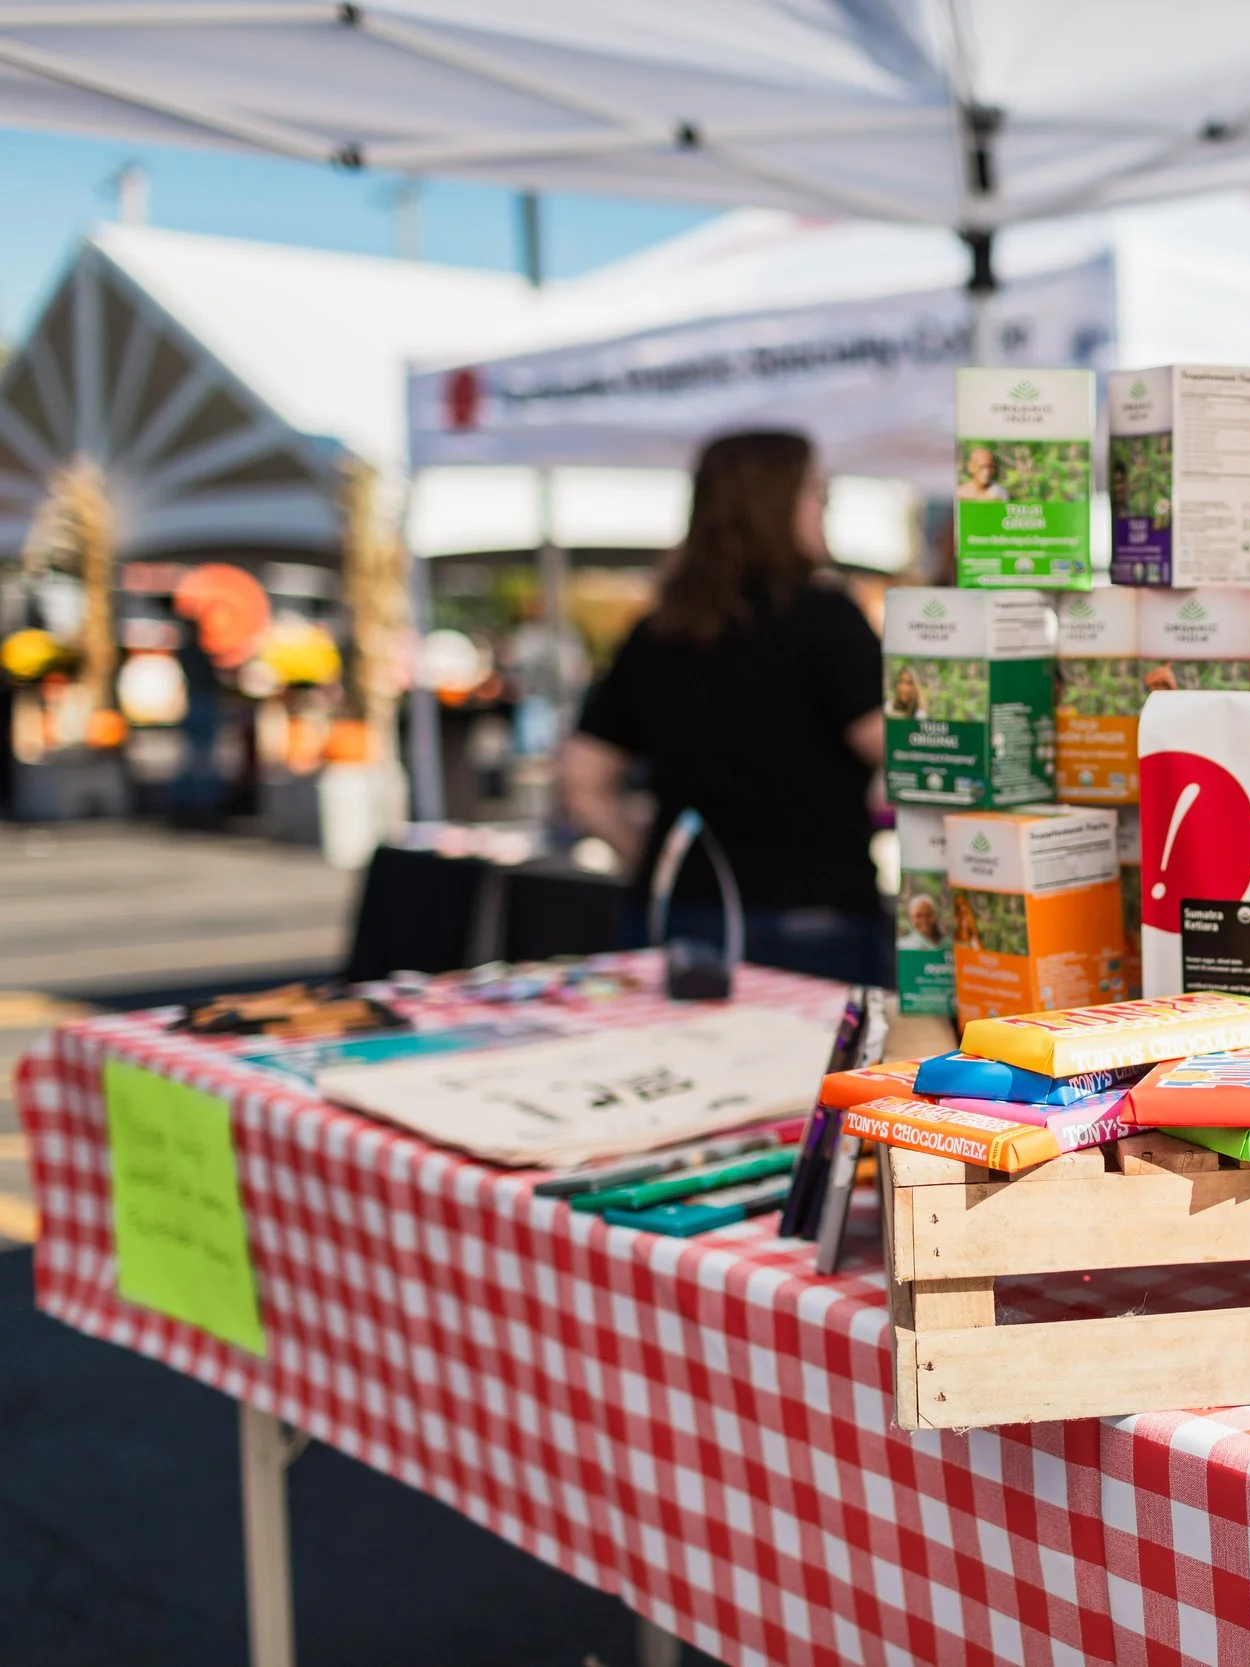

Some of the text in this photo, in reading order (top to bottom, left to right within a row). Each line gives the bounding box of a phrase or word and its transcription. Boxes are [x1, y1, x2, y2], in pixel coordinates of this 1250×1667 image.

[1184, 907, 1224, 922] Sumatra
[1069, 1039, 1145, 1074] TONY'S
[1068, 1068, 1114, 1097] TONY'S
[848, 1112, 890, 1139] TONY'S
[1062, 1114, 1130, 1149] TONY'S
